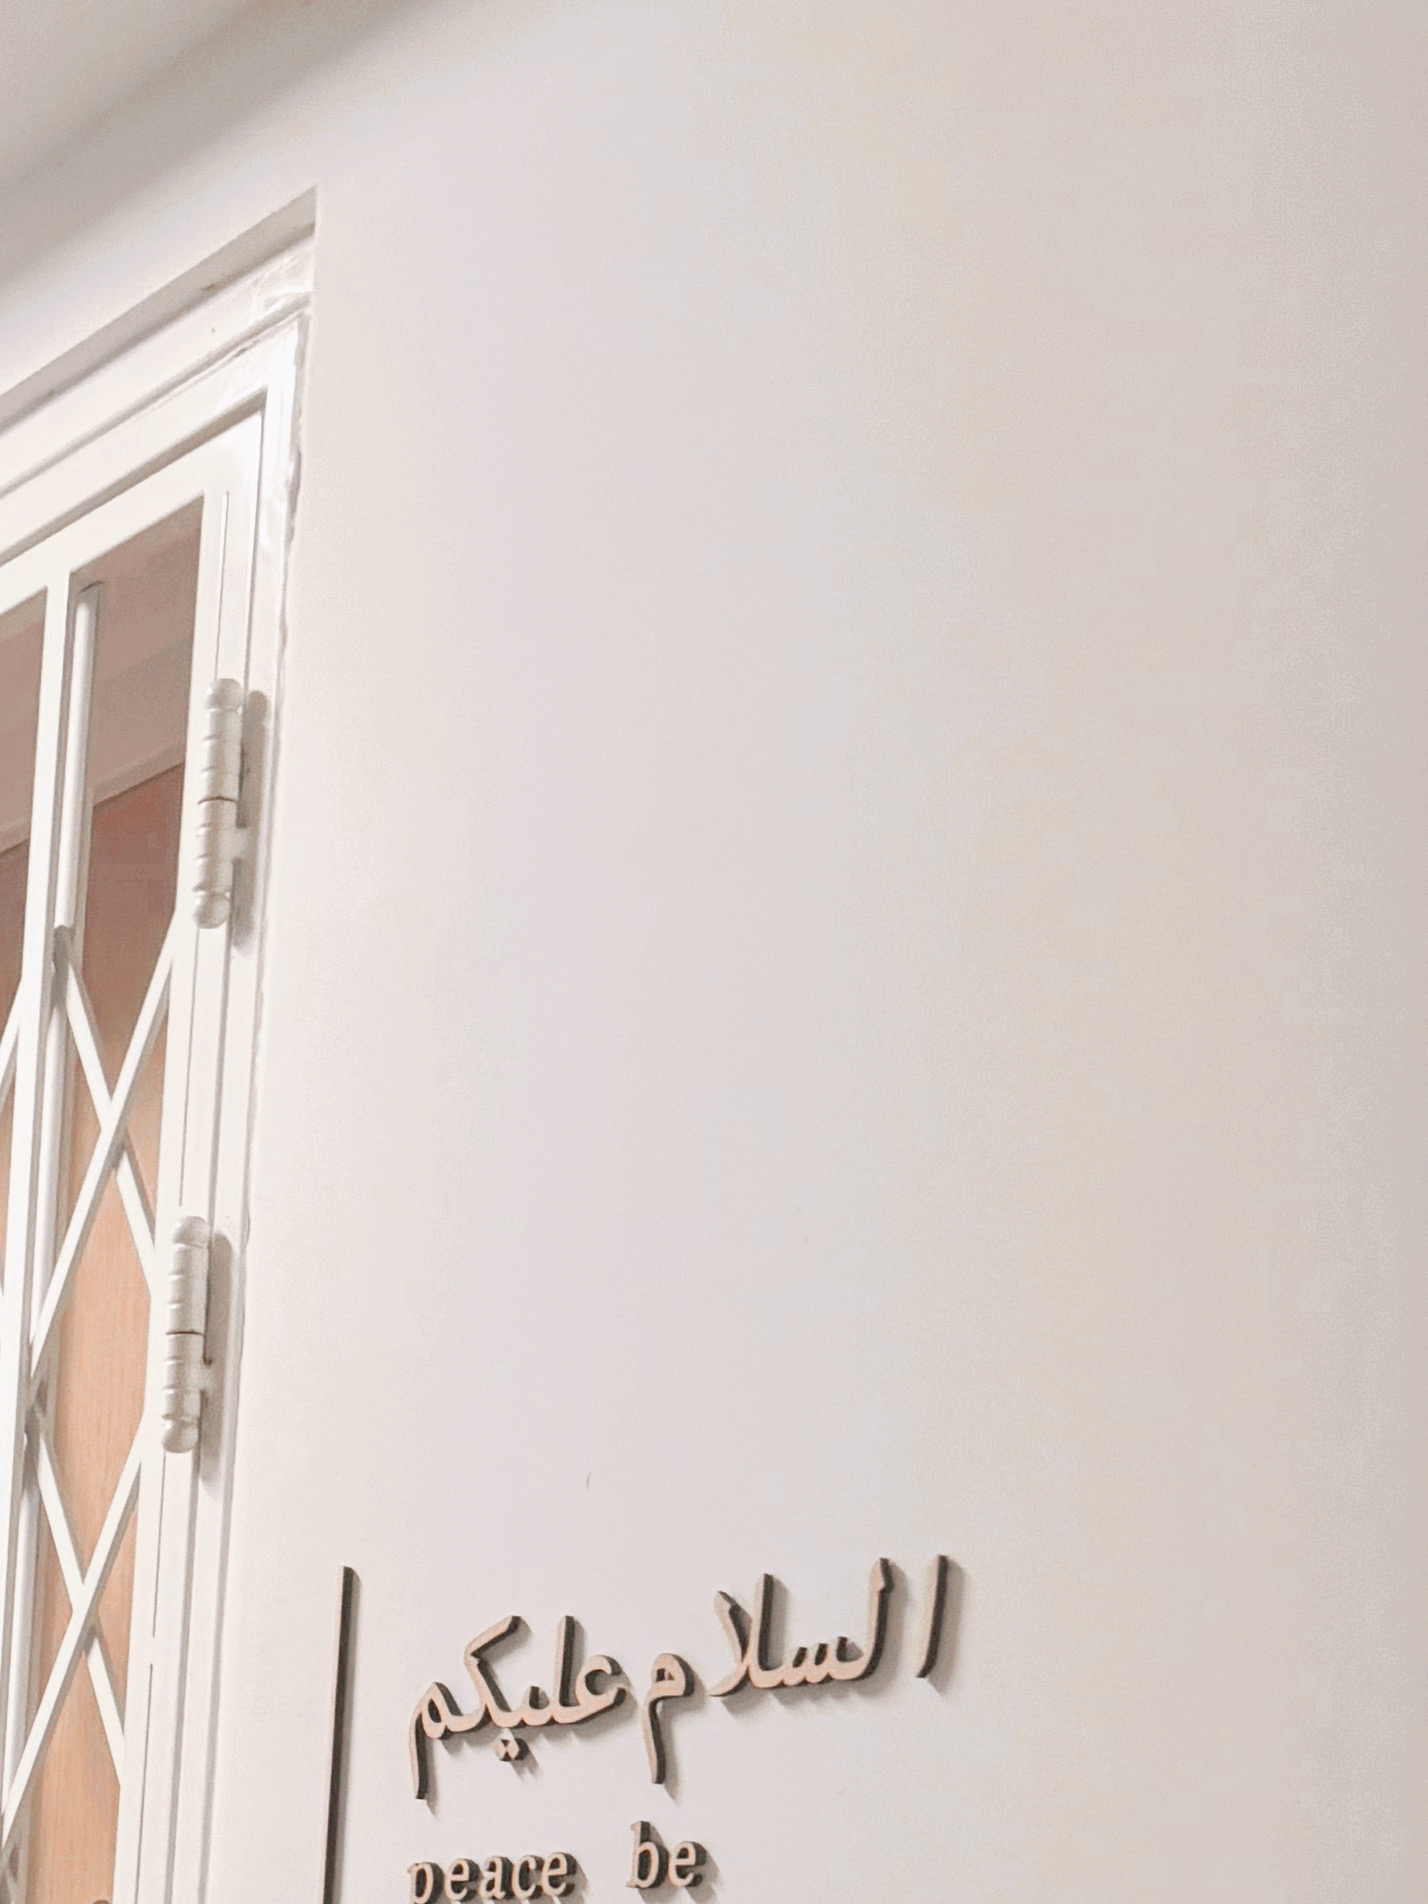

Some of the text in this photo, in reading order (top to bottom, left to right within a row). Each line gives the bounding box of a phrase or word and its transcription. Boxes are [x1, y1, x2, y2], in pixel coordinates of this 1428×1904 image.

[408, 1554, 949, 1801] السلام عليكم
[626, 1820, 708, 1890] be
